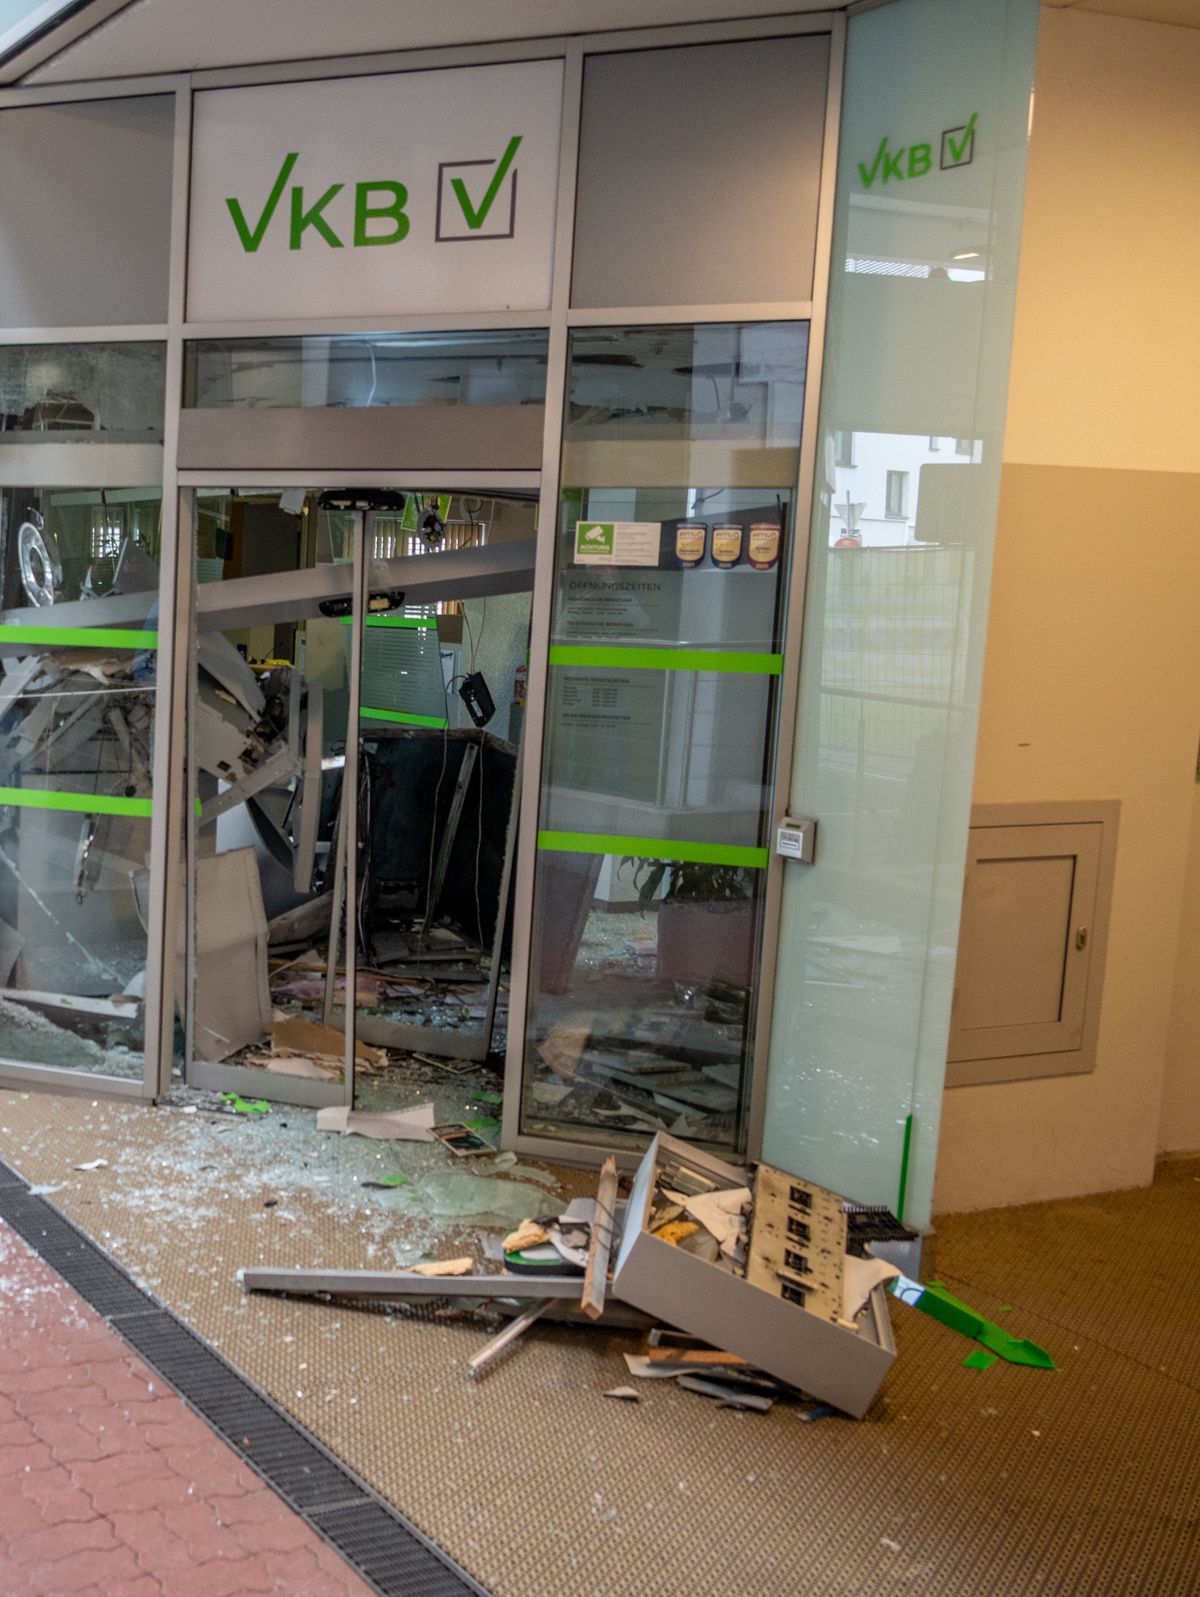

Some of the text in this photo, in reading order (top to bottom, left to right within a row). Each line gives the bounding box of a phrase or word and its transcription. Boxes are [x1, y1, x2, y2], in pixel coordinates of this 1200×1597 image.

[857, 135, 932, 189] VKB
[225, 152, 411, 253] VKB
[568, 581, 662, 592] ÖFFNUNGSZEITEN
